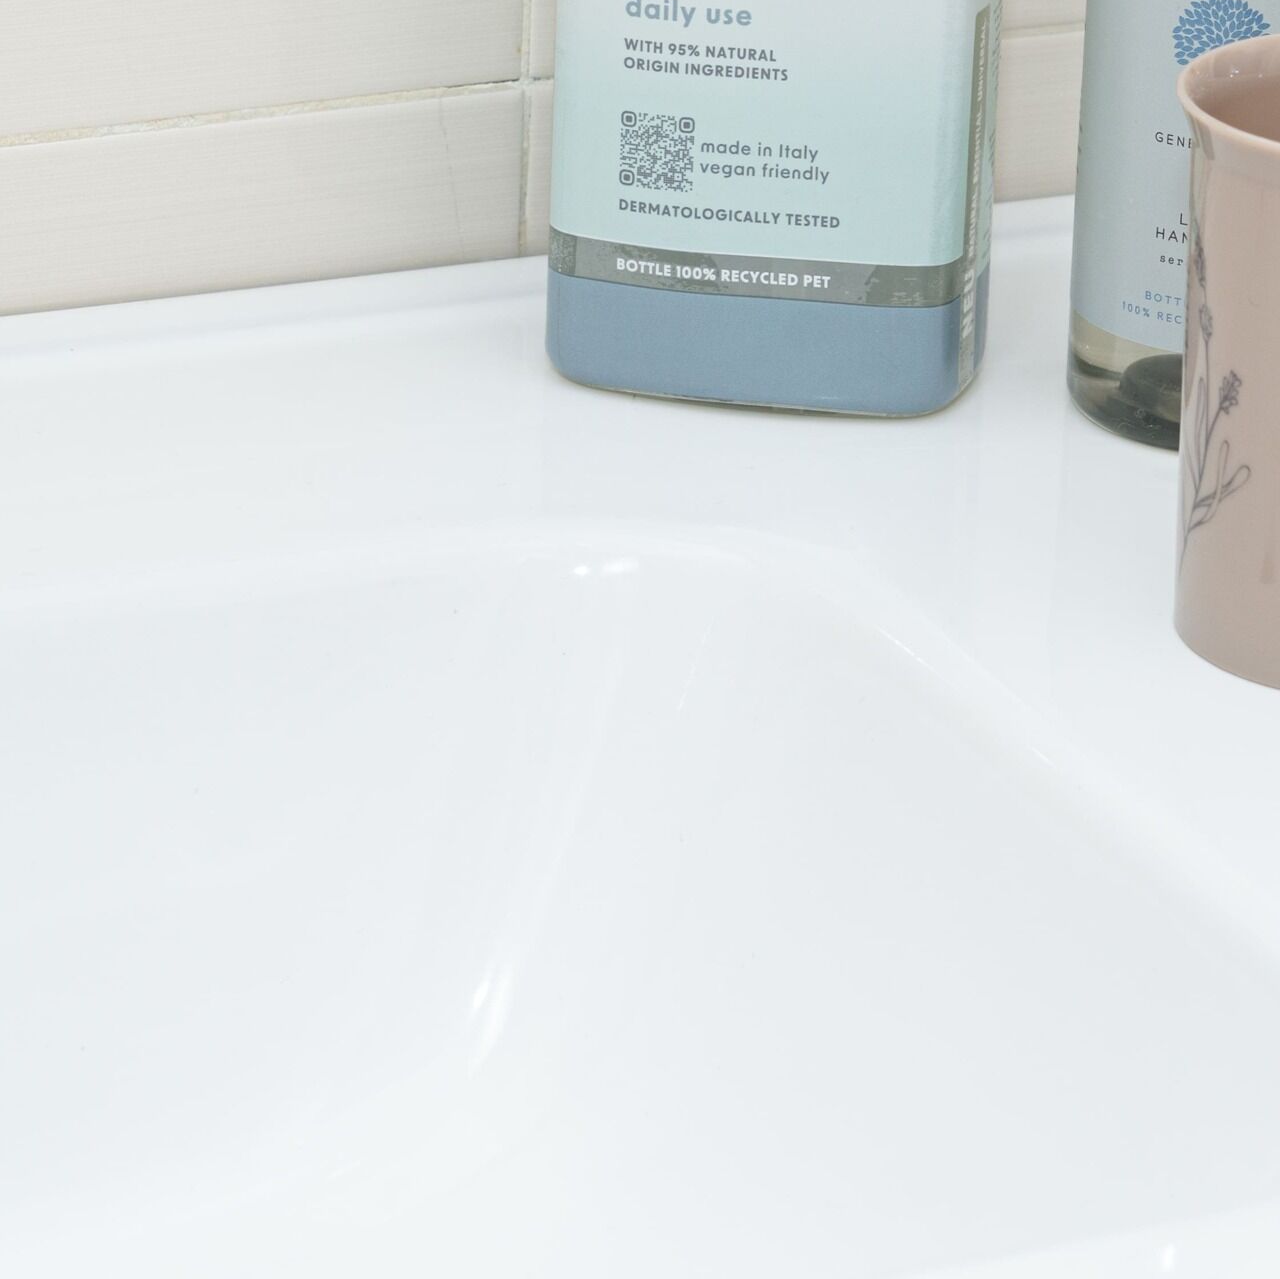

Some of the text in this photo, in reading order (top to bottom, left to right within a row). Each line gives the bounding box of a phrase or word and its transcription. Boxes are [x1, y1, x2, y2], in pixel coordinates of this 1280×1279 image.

[706, 8, 752, 26] use
[624, 38, 777, 62] WITH 95% NATURAL
[623, 57, 788, 81] ORIGIN INGREDIENTS
[700, 141, 819, 162] made in Italy
[700, 162, 830, 185] vegan friendly
[619, 198, 840, 229] DERMATOLOGICALLY TESTED
[616, 258, 831, 289] BOTTLE 100% RECYCLED PET
[1122, 300, 1152, 318] 100%
